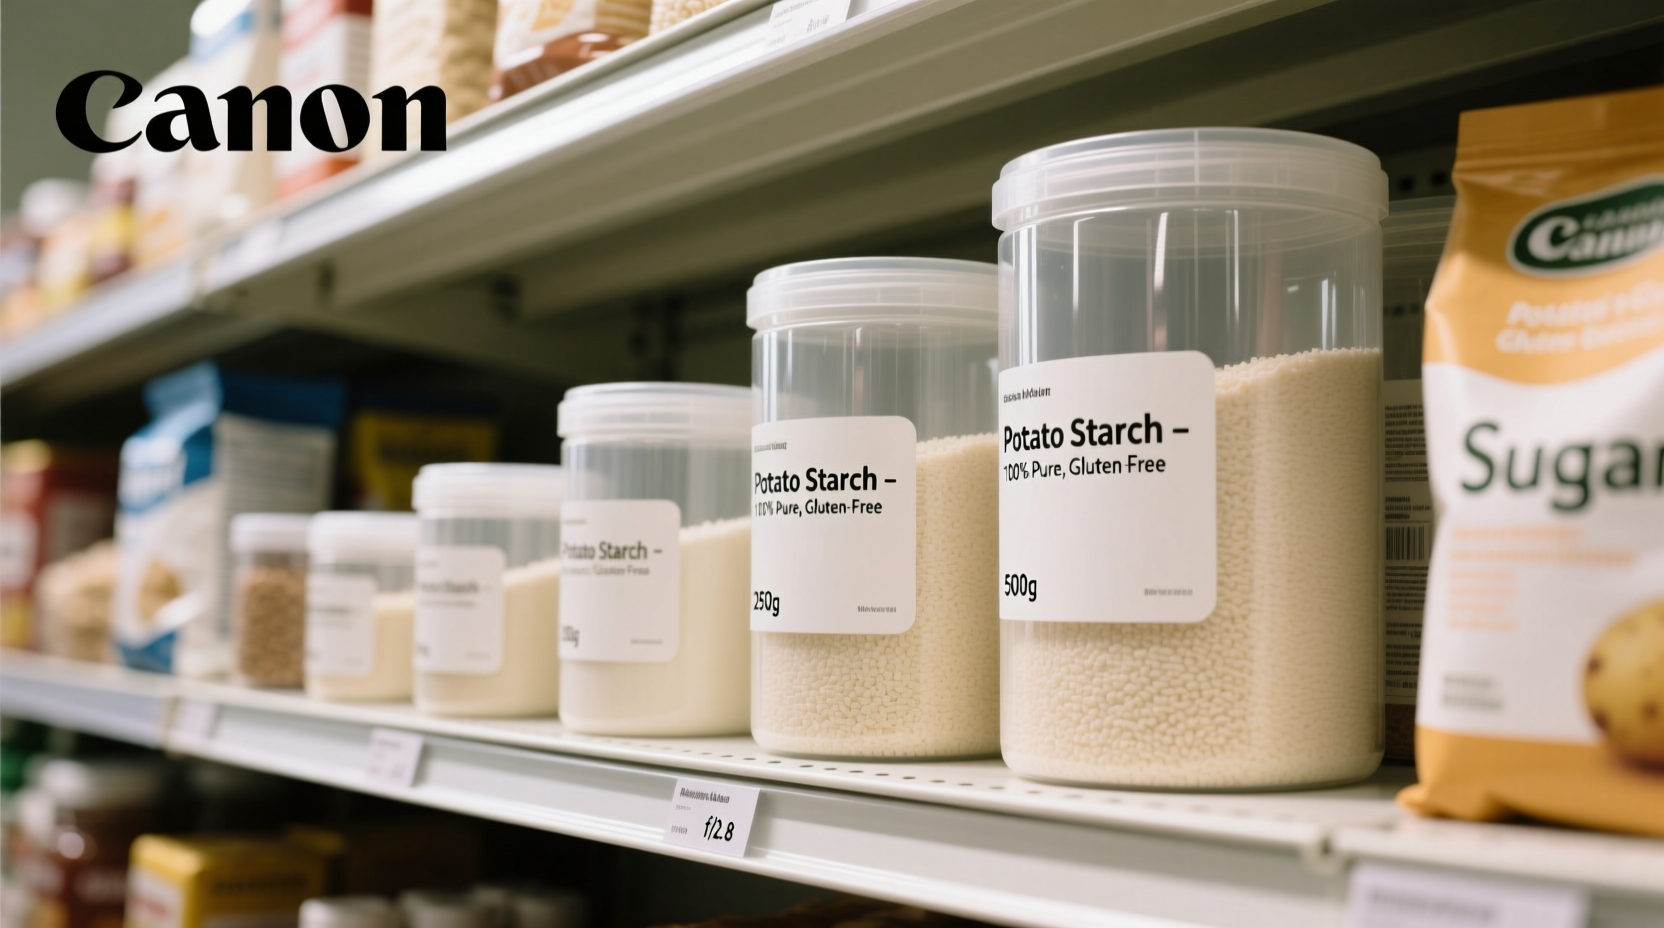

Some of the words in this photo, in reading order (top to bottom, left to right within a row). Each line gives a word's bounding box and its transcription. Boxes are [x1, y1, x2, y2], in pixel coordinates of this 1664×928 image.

[1003, 422, 1064, 453] Potato
[1070, 412, 1163, 447] Starch
[754, 470, 800, 495] Potato
[805, 465, 877, 492] Starch
[1003, 461, 1029, 482] 100%
[1032, 460, 1066, 480] Pure,
[776, 500, 802, 518] Pure,
[805, 498, 883, 514] Gluten-Free
[599, 539, 648, 560] Starch
[1004, 572, 1037, 602] 500g
[753, 590, 780, 617] 250g
